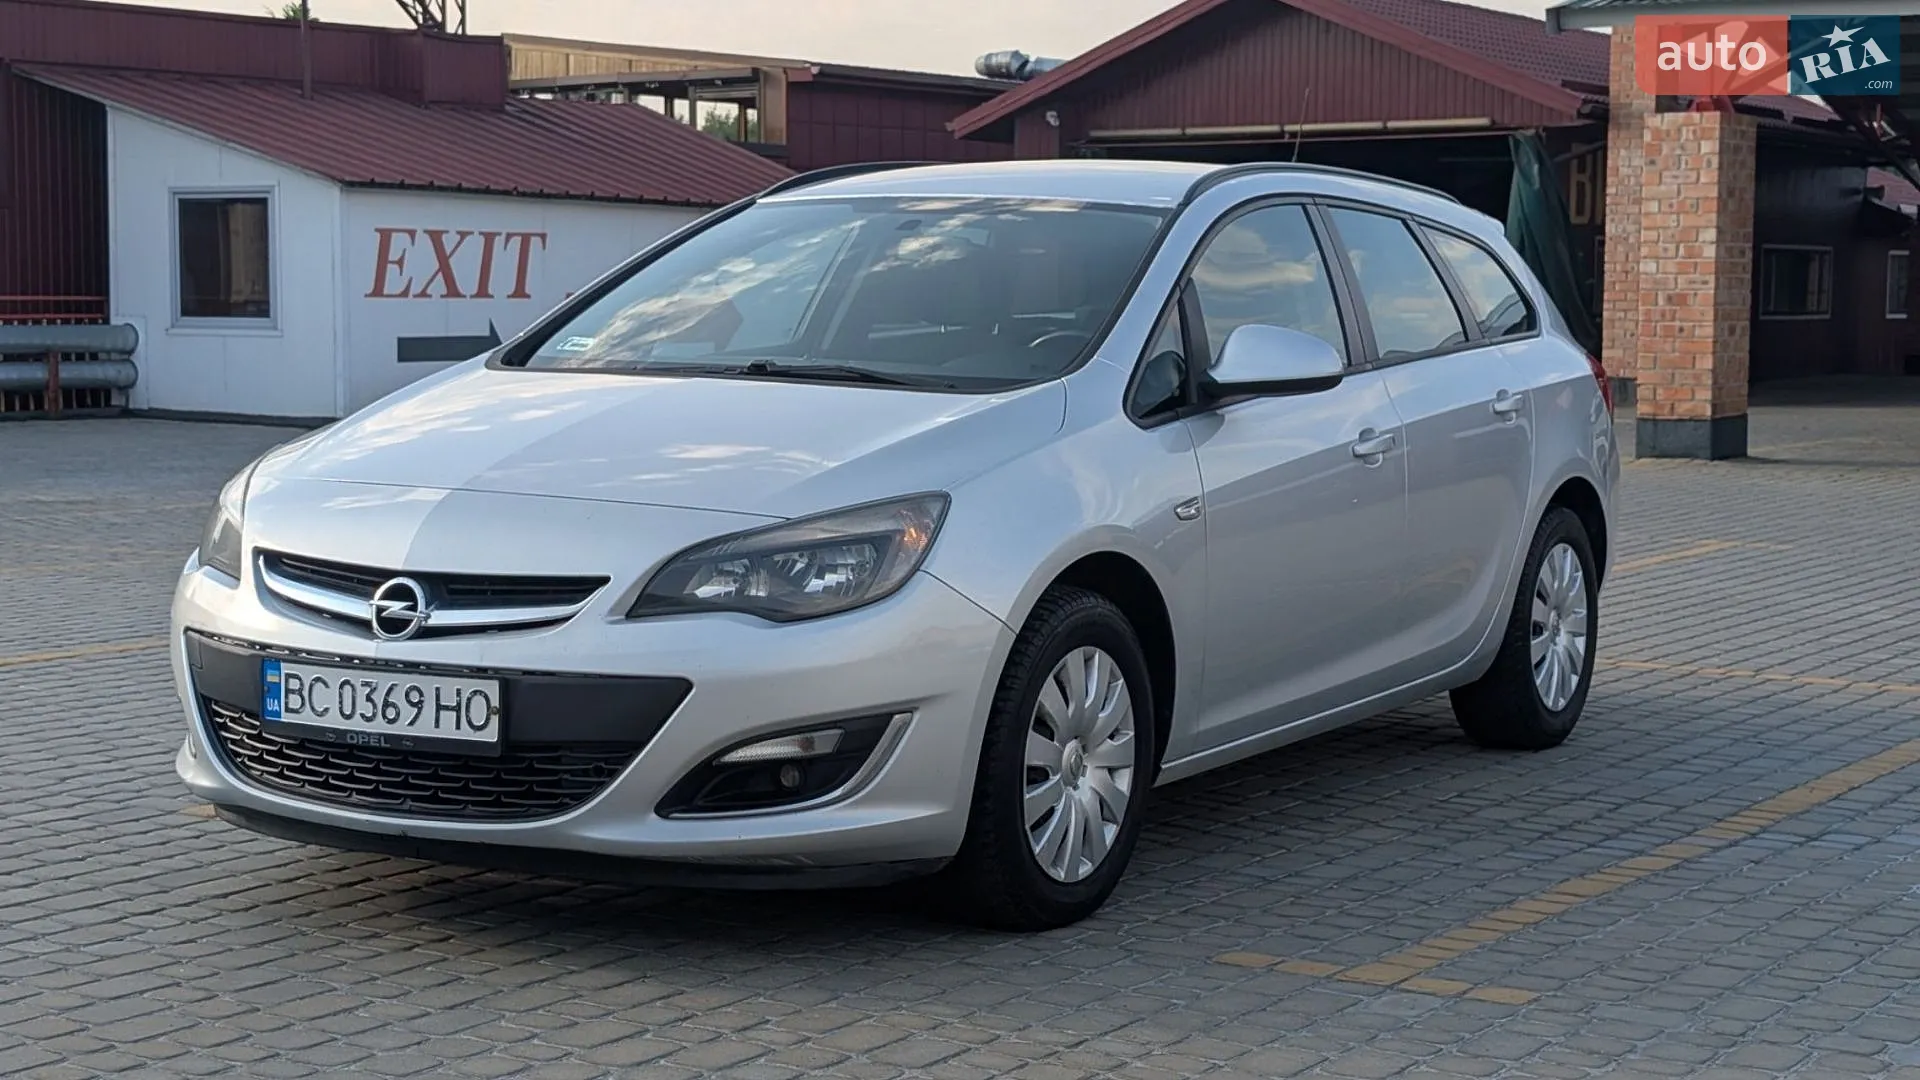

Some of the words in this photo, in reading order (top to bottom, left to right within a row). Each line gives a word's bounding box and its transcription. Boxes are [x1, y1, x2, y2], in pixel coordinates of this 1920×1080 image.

[364, 227, 547, 299] EXIT
[266, 697, 280, 712] UA
[283, 672, 330, 718] BC
[338, 678, 425, 727] 0369
[433, 686, 493, 732] HO
[346, 733, 391, 748] OPEL
